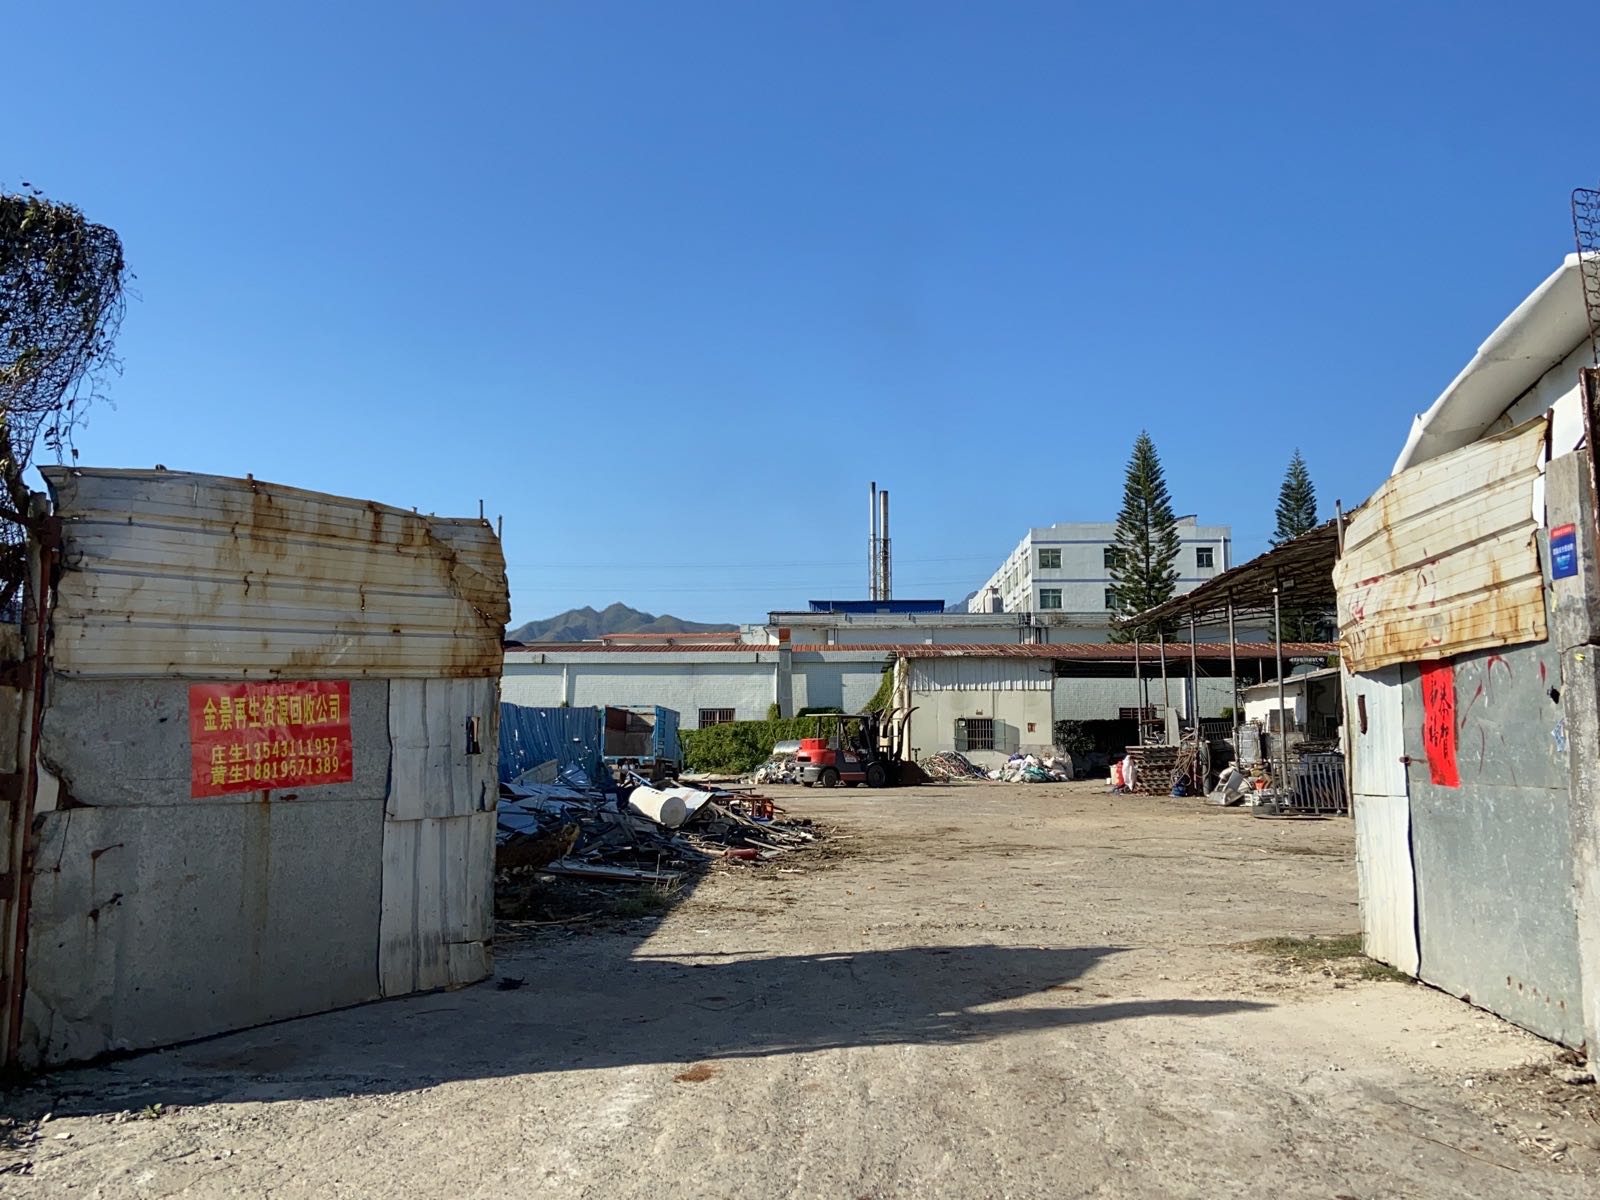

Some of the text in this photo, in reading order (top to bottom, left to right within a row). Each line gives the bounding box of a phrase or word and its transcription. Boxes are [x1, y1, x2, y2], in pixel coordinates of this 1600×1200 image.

[203, 694, 340, 731] 金景再生资源回收公司
